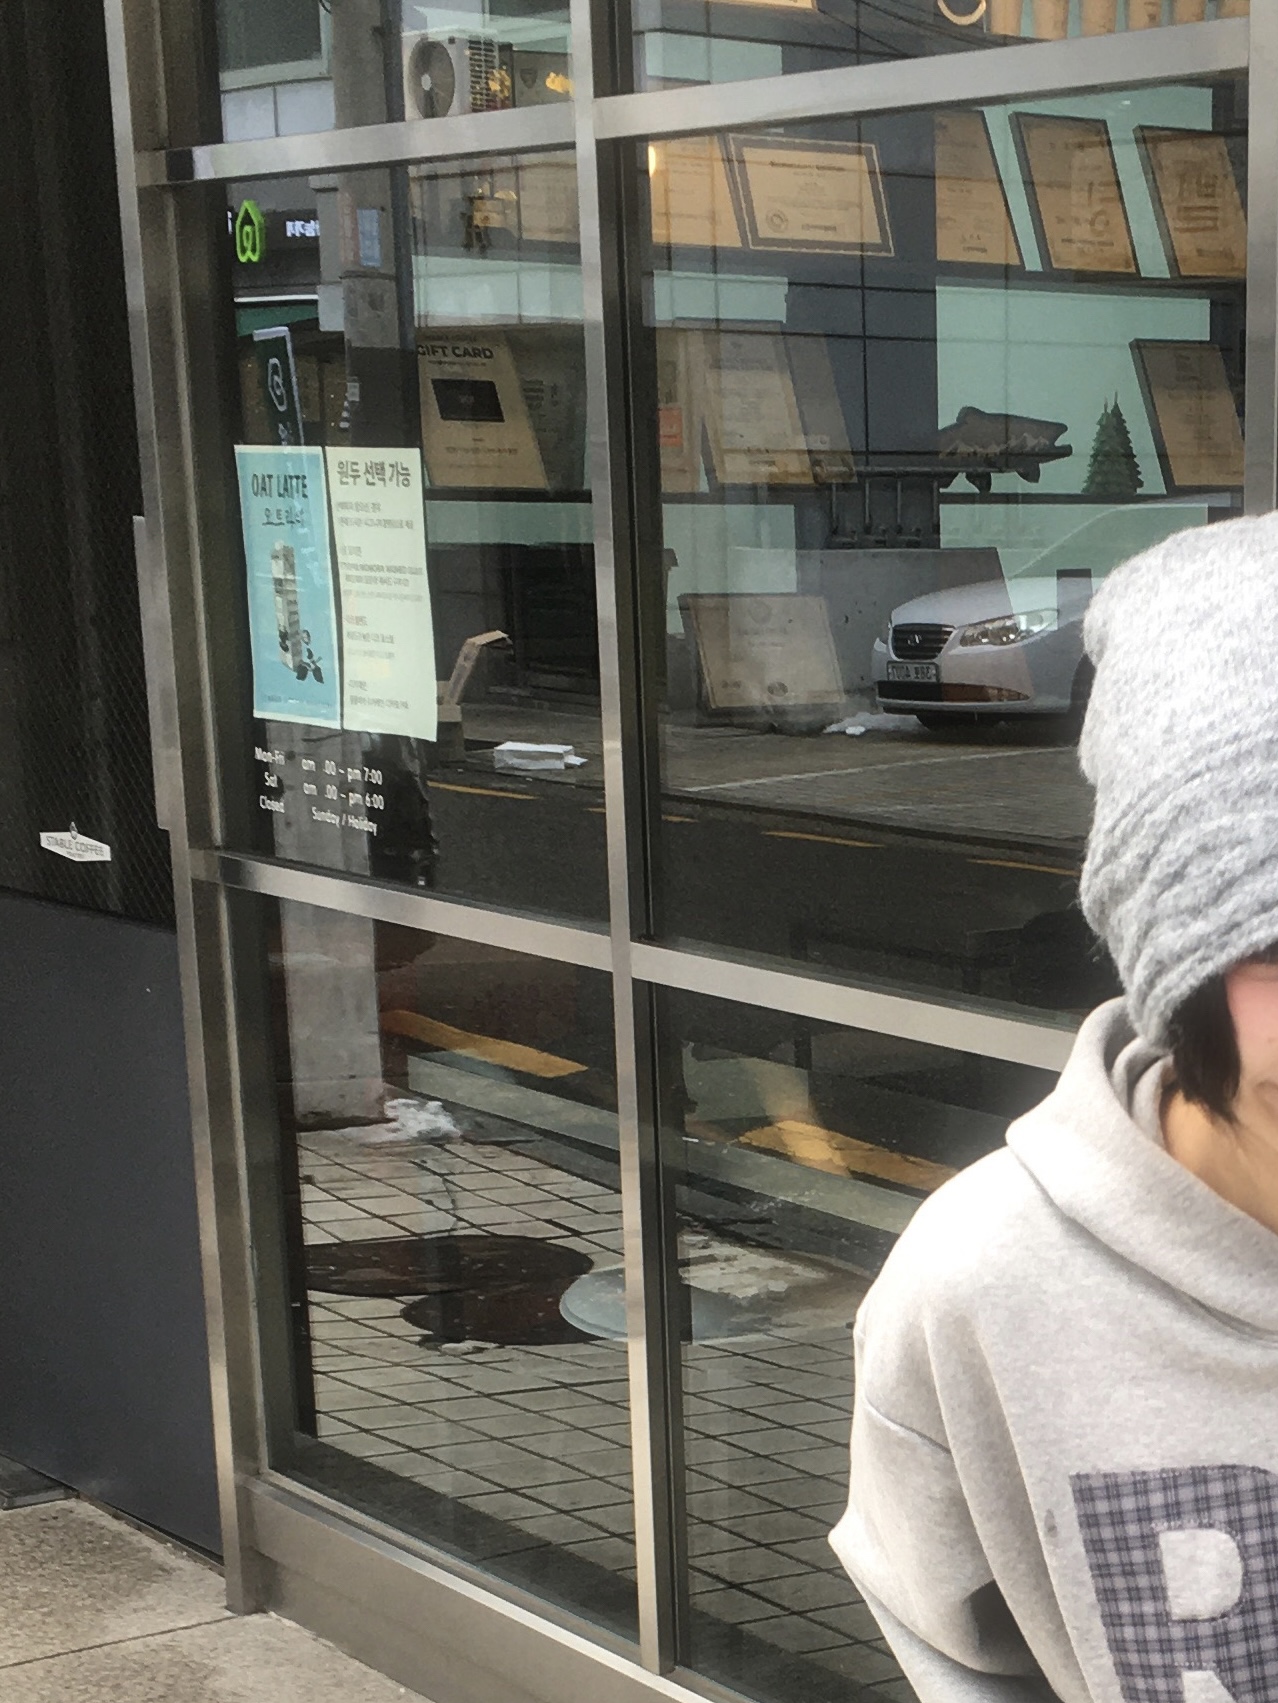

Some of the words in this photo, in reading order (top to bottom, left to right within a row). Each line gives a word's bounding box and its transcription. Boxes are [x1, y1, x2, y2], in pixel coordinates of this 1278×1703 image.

[417, 344, 448, 358] GIFT
[451, 346, 494, 359] CARD
[252, 473, 273, 498] OAT
[277, 474, 308, 499] LATTE
[337, 460, 361, 486] 원두
[363, 460, 386, 487] 선택
[388, 460, 411, 488] 가능
[255, 746, 285, 765] Mon-Fri
[302, 758, 316, 772] am
[347, 767, 362, 782] pm
[363, 766, 383, 785] 7:00
[264, 771, 278, 788] Sat
[303, 782, 317, 796] am
[348, 791, 363, 807] pm
[365, 792, 385, 810] 6:00
[260, 794, 285, 813] Closed
[312, 806, 340, 828] Sunday
[348, 814, 378, 836] Holiday
